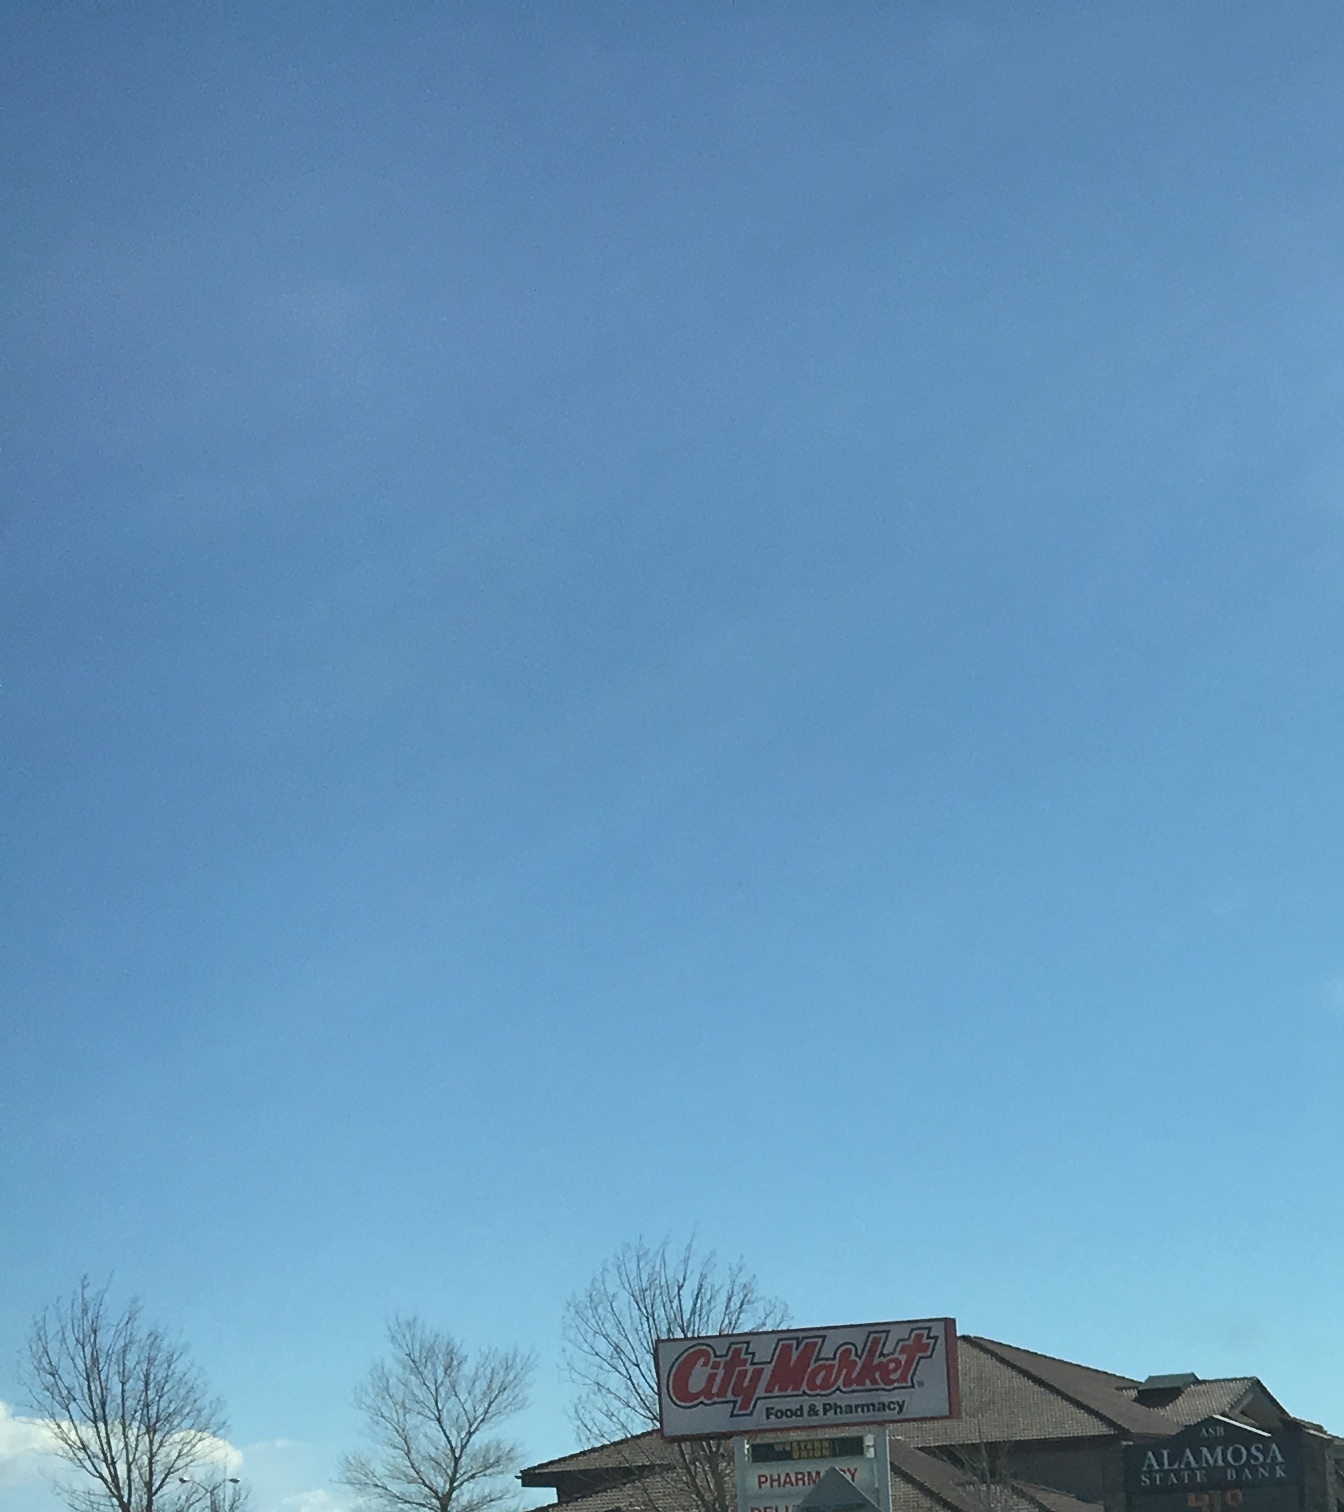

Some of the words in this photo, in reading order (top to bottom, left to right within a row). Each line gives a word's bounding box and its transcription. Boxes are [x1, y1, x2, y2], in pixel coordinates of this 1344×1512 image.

[669, 1342, 766, 1414] City
[764, 1330, 933, 1394] Market
[765, 1405, 804, 1421] Food
[807, 1403, 820, 1418] &
[822, 1400, 906, 1416] Pharmacy
[1200, 1426, 1225, 1438] ASB
[1142, 1443, 1286, 1471] ALAMOSA
[757, 1467, 858, 1489] PHARMY
[1140, 1470, 1207, 1487] STATE
[1226, 1465, 1287, 1481] BANK
